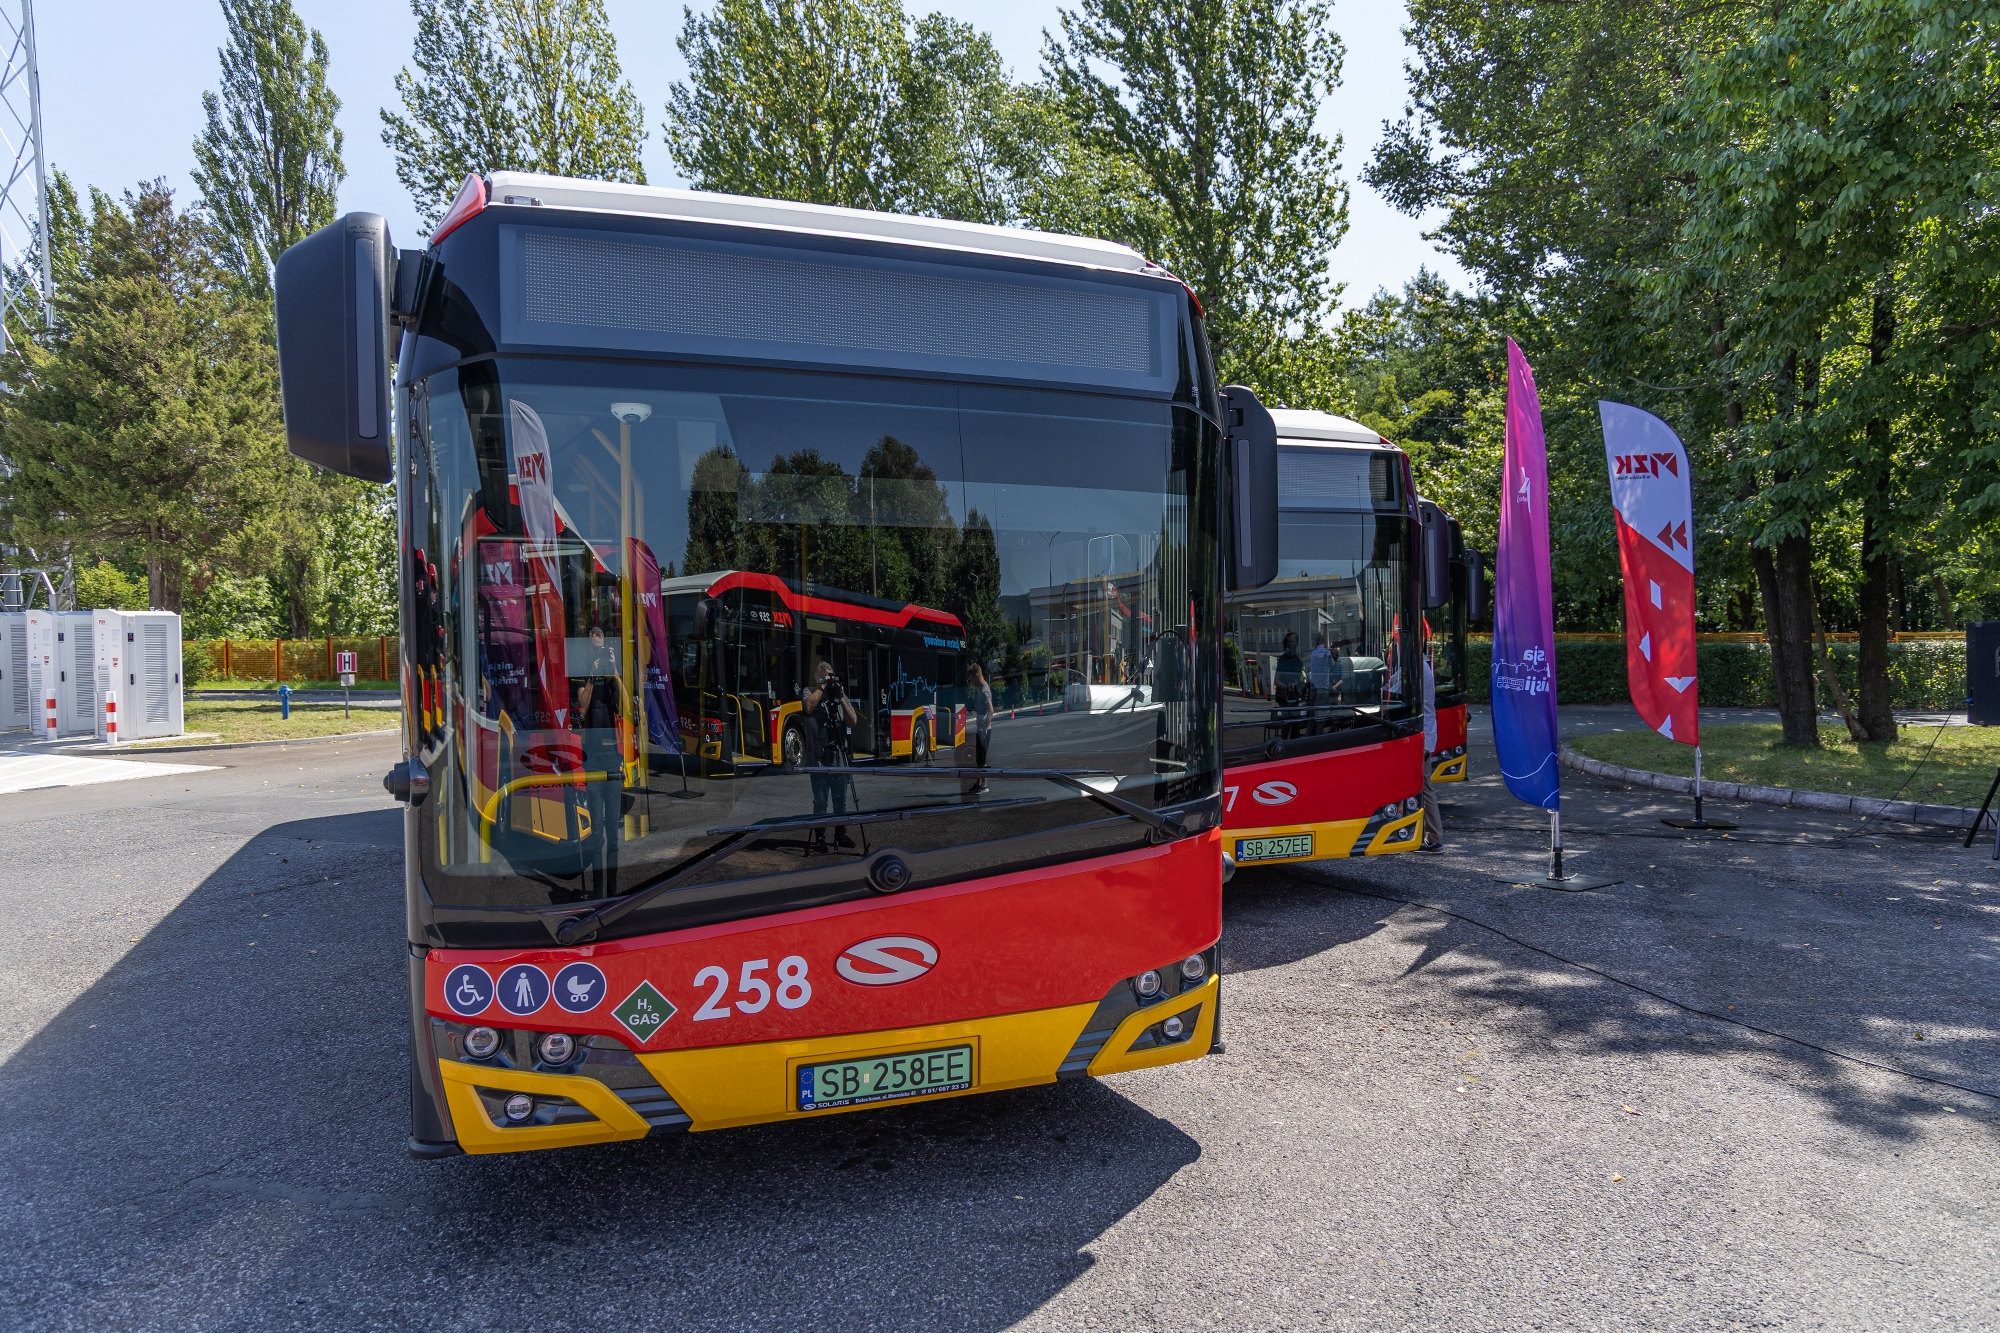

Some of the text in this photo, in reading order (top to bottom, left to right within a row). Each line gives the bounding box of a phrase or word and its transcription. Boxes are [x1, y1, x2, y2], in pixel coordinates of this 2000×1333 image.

[343, 654, 351, 671] H
[1246, 837, 1309, 856] SB 257EE
[692, 954, 812, 1022] 258
[628, 1012, 660, 1026] GAS
[821, 1051, 964, 1098] SB 258EE
[801, 1089, 813, 1099] PL
[817, 1099, 850, 1109] SOLARIS
